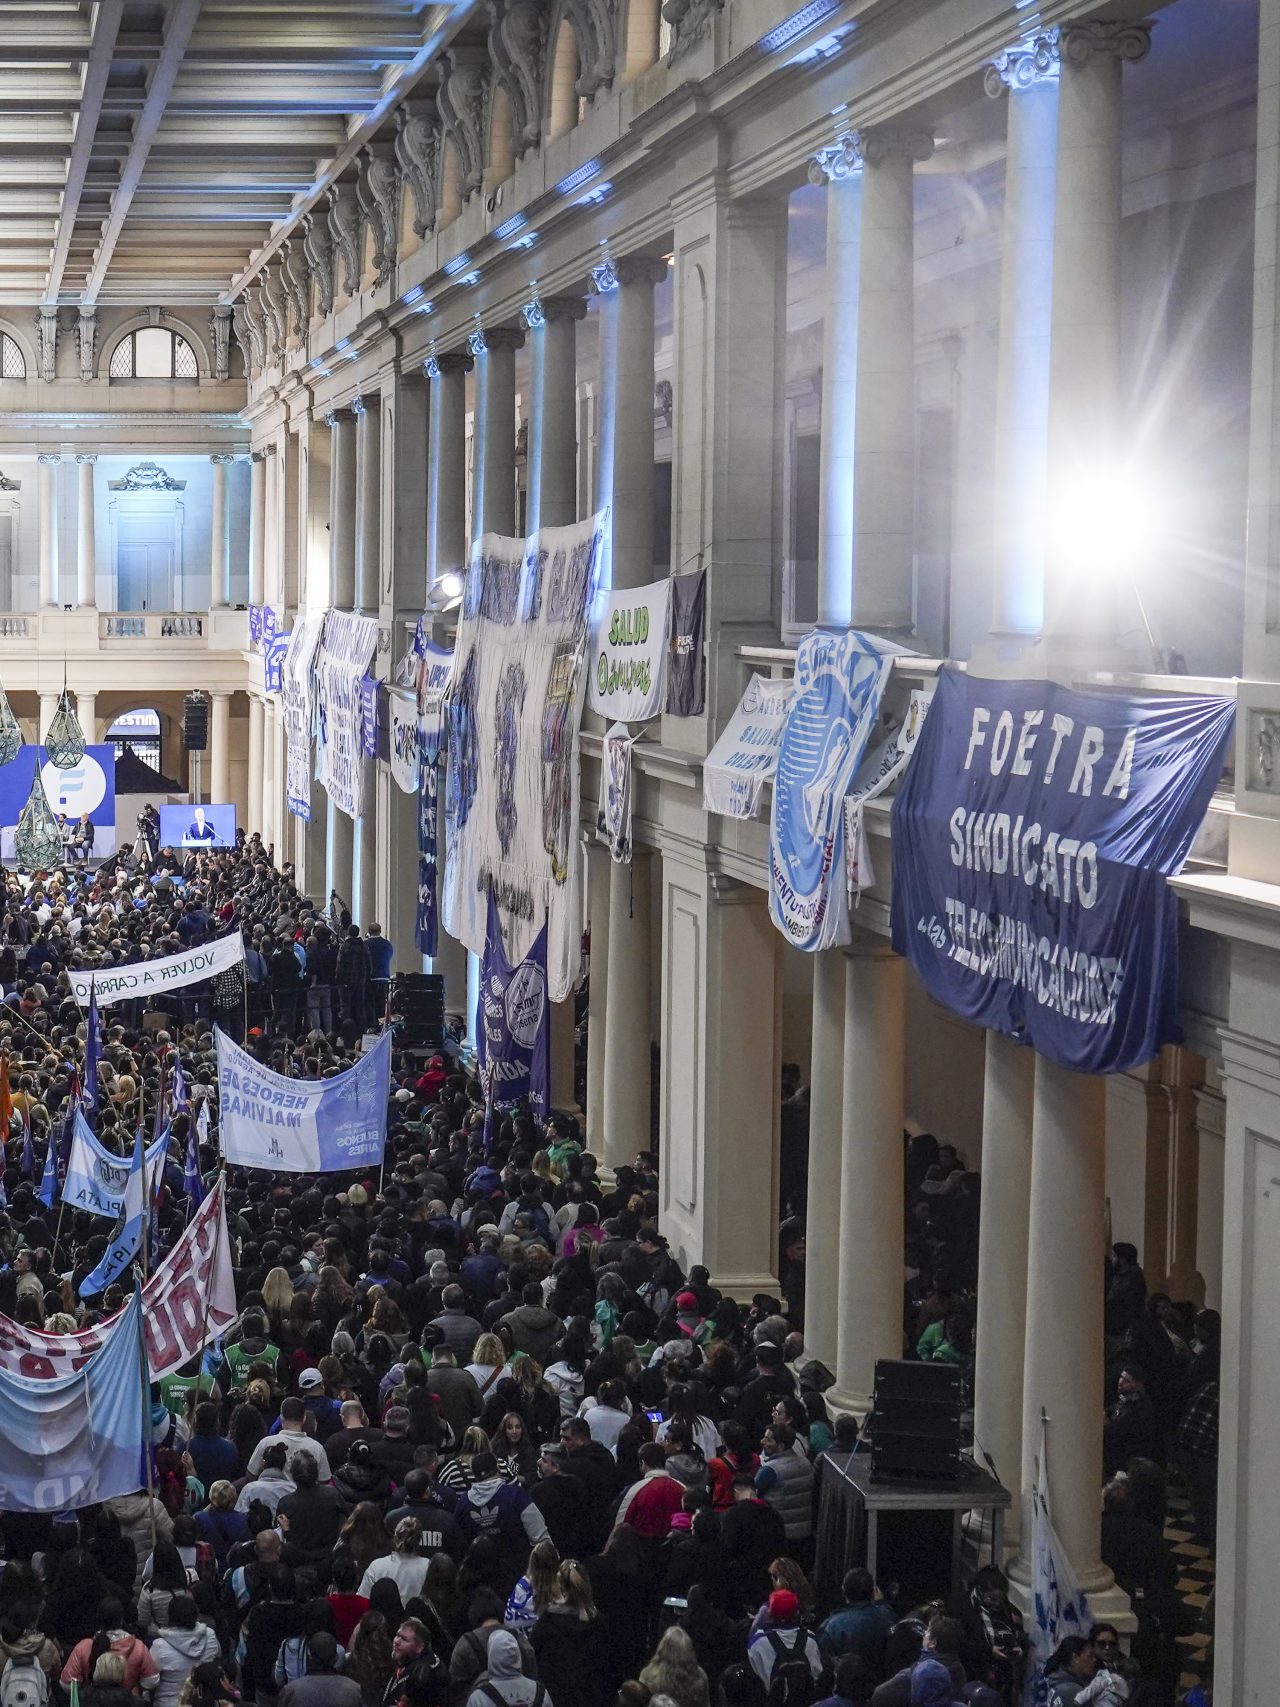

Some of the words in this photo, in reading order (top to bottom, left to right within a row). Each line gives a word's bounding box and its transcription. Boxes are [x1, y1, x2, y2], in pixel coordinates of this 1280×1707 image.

[608, 606, 650, 646] SALUD
[964, 707, 1138, 800] FOETRA
[949, 806, 1098, 909] SINDICATO
